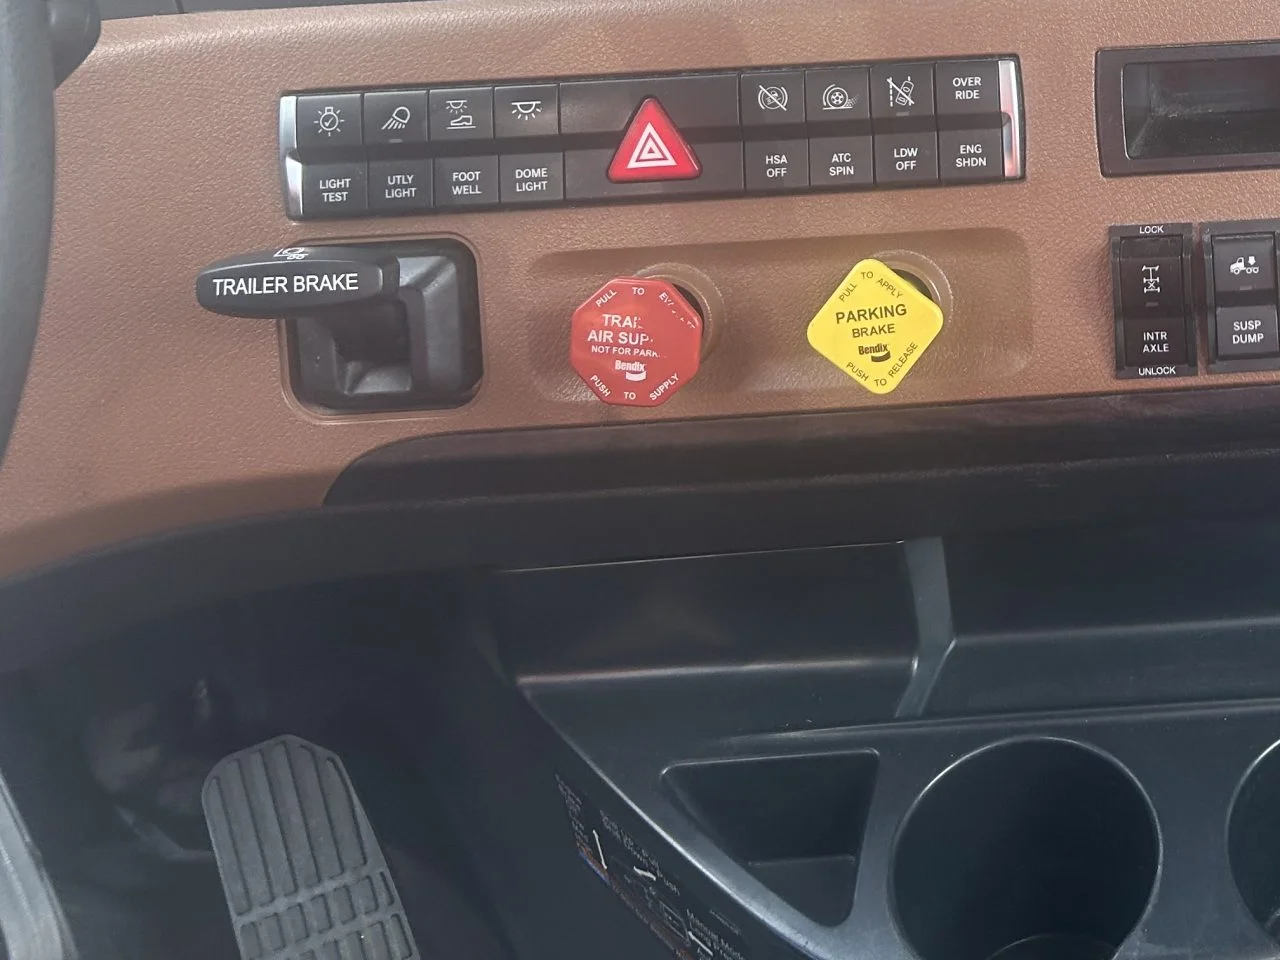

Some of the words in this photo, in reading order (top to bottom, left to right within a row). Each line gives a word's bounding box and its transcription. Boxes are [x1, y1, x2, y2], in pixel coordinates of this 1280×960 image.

[952, 76, 982, 89] OVER
[955, 89, 980, 101] RIDE
[893, 147, 918, 159] LDW
[959, 144, 983, 156] ENG
[765, 154, 788, 166] HSA
[831, 152, 852, 164] ATC
[956, 156, 987, 169] SHDN
[829, 165, 854, 177] SPIN
[895, 159, 917, 171] OFF
[452, 171, 481, 182] FOOT
[515, 167, 548, 179] DOME
[766, 167, 787, 178] OFF
[319, 178, 351, 190] LIGHT
[387, 174, 414, 186] UTLY
[452, 184, 482, 195] WELL
[516, 181, 548, 192] LIGHT
[322, 191, 348, 203] TEST
[385, 187, 416, 199] LIGHT
[1139, 225, 1165, 234] LOCK
[212, 276, 289, 296] TRAILER
[293, 273, 359, 293] BRAKE
[838, 282, 858, 302] PULL
[860, 271, 874, 279] TO
[876, 278, 904, 299] APPLY
[595, 289, 617, 307] PULL
[632, 287, 645, 296] TO
[835, 303, 907, 324] PARKING
[602, 313, 643, 329] TRAI
[1233, 320, 1262, 331] SUSP
[851, 323, 896, 338] BRAKE
[1143, 331, 1168, 341] INTR
[587, 329, 614, 343] AIR
[618, 331, 653, 346] SUP
[1232, 333, 1264, 344] DUMP
[591, 345, 611, 354] NOT
[612, 346, 631, 355] FOR
[633, 348, 662, 358] PARK
[858, 343, 889, 356] Bendix
[1142, 343, 1170, 353] AXLE
[614, 360, 646, 372] Bendix
[846, 362, 870, 382] PUSH
[873, 378, 887, 387] TO
[888, 342, 919, 378] RELEASE
[1138, 366, 1176, 376] UNLOCK
[590, 374, 611, 397] PUSH
[624, 392, 636, 400] TO
[650, 373, 680, 401] SUPPLY
